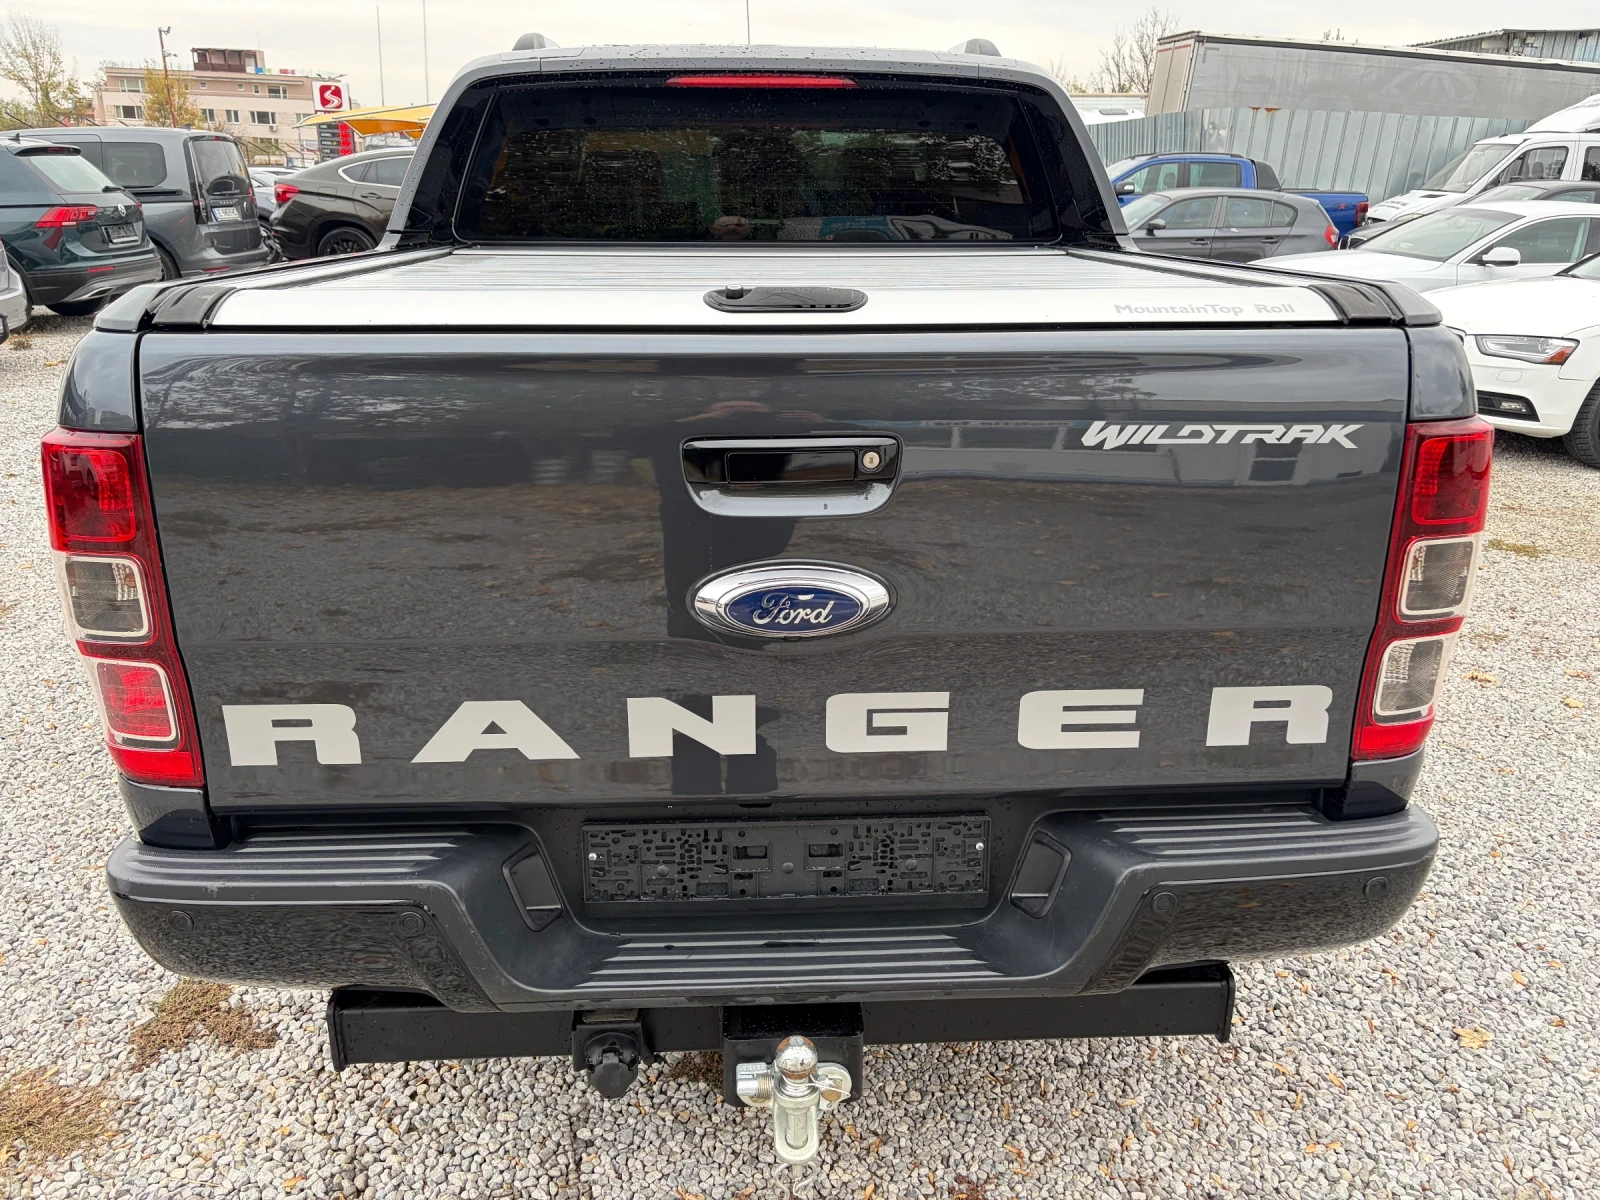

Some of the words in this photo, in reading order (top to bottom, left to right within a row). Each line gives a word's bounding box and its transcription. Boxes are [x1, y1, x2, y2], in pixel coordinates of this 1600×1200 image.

[1113, 303, 1244, 316] MountainTop
[1254, 303, 1296, 314] Roll
[1081, 420, 1365, 450] WILDTRAK
[752, 592, 834, 625] Ford
[221, 684, 1334, 767] RANGER
